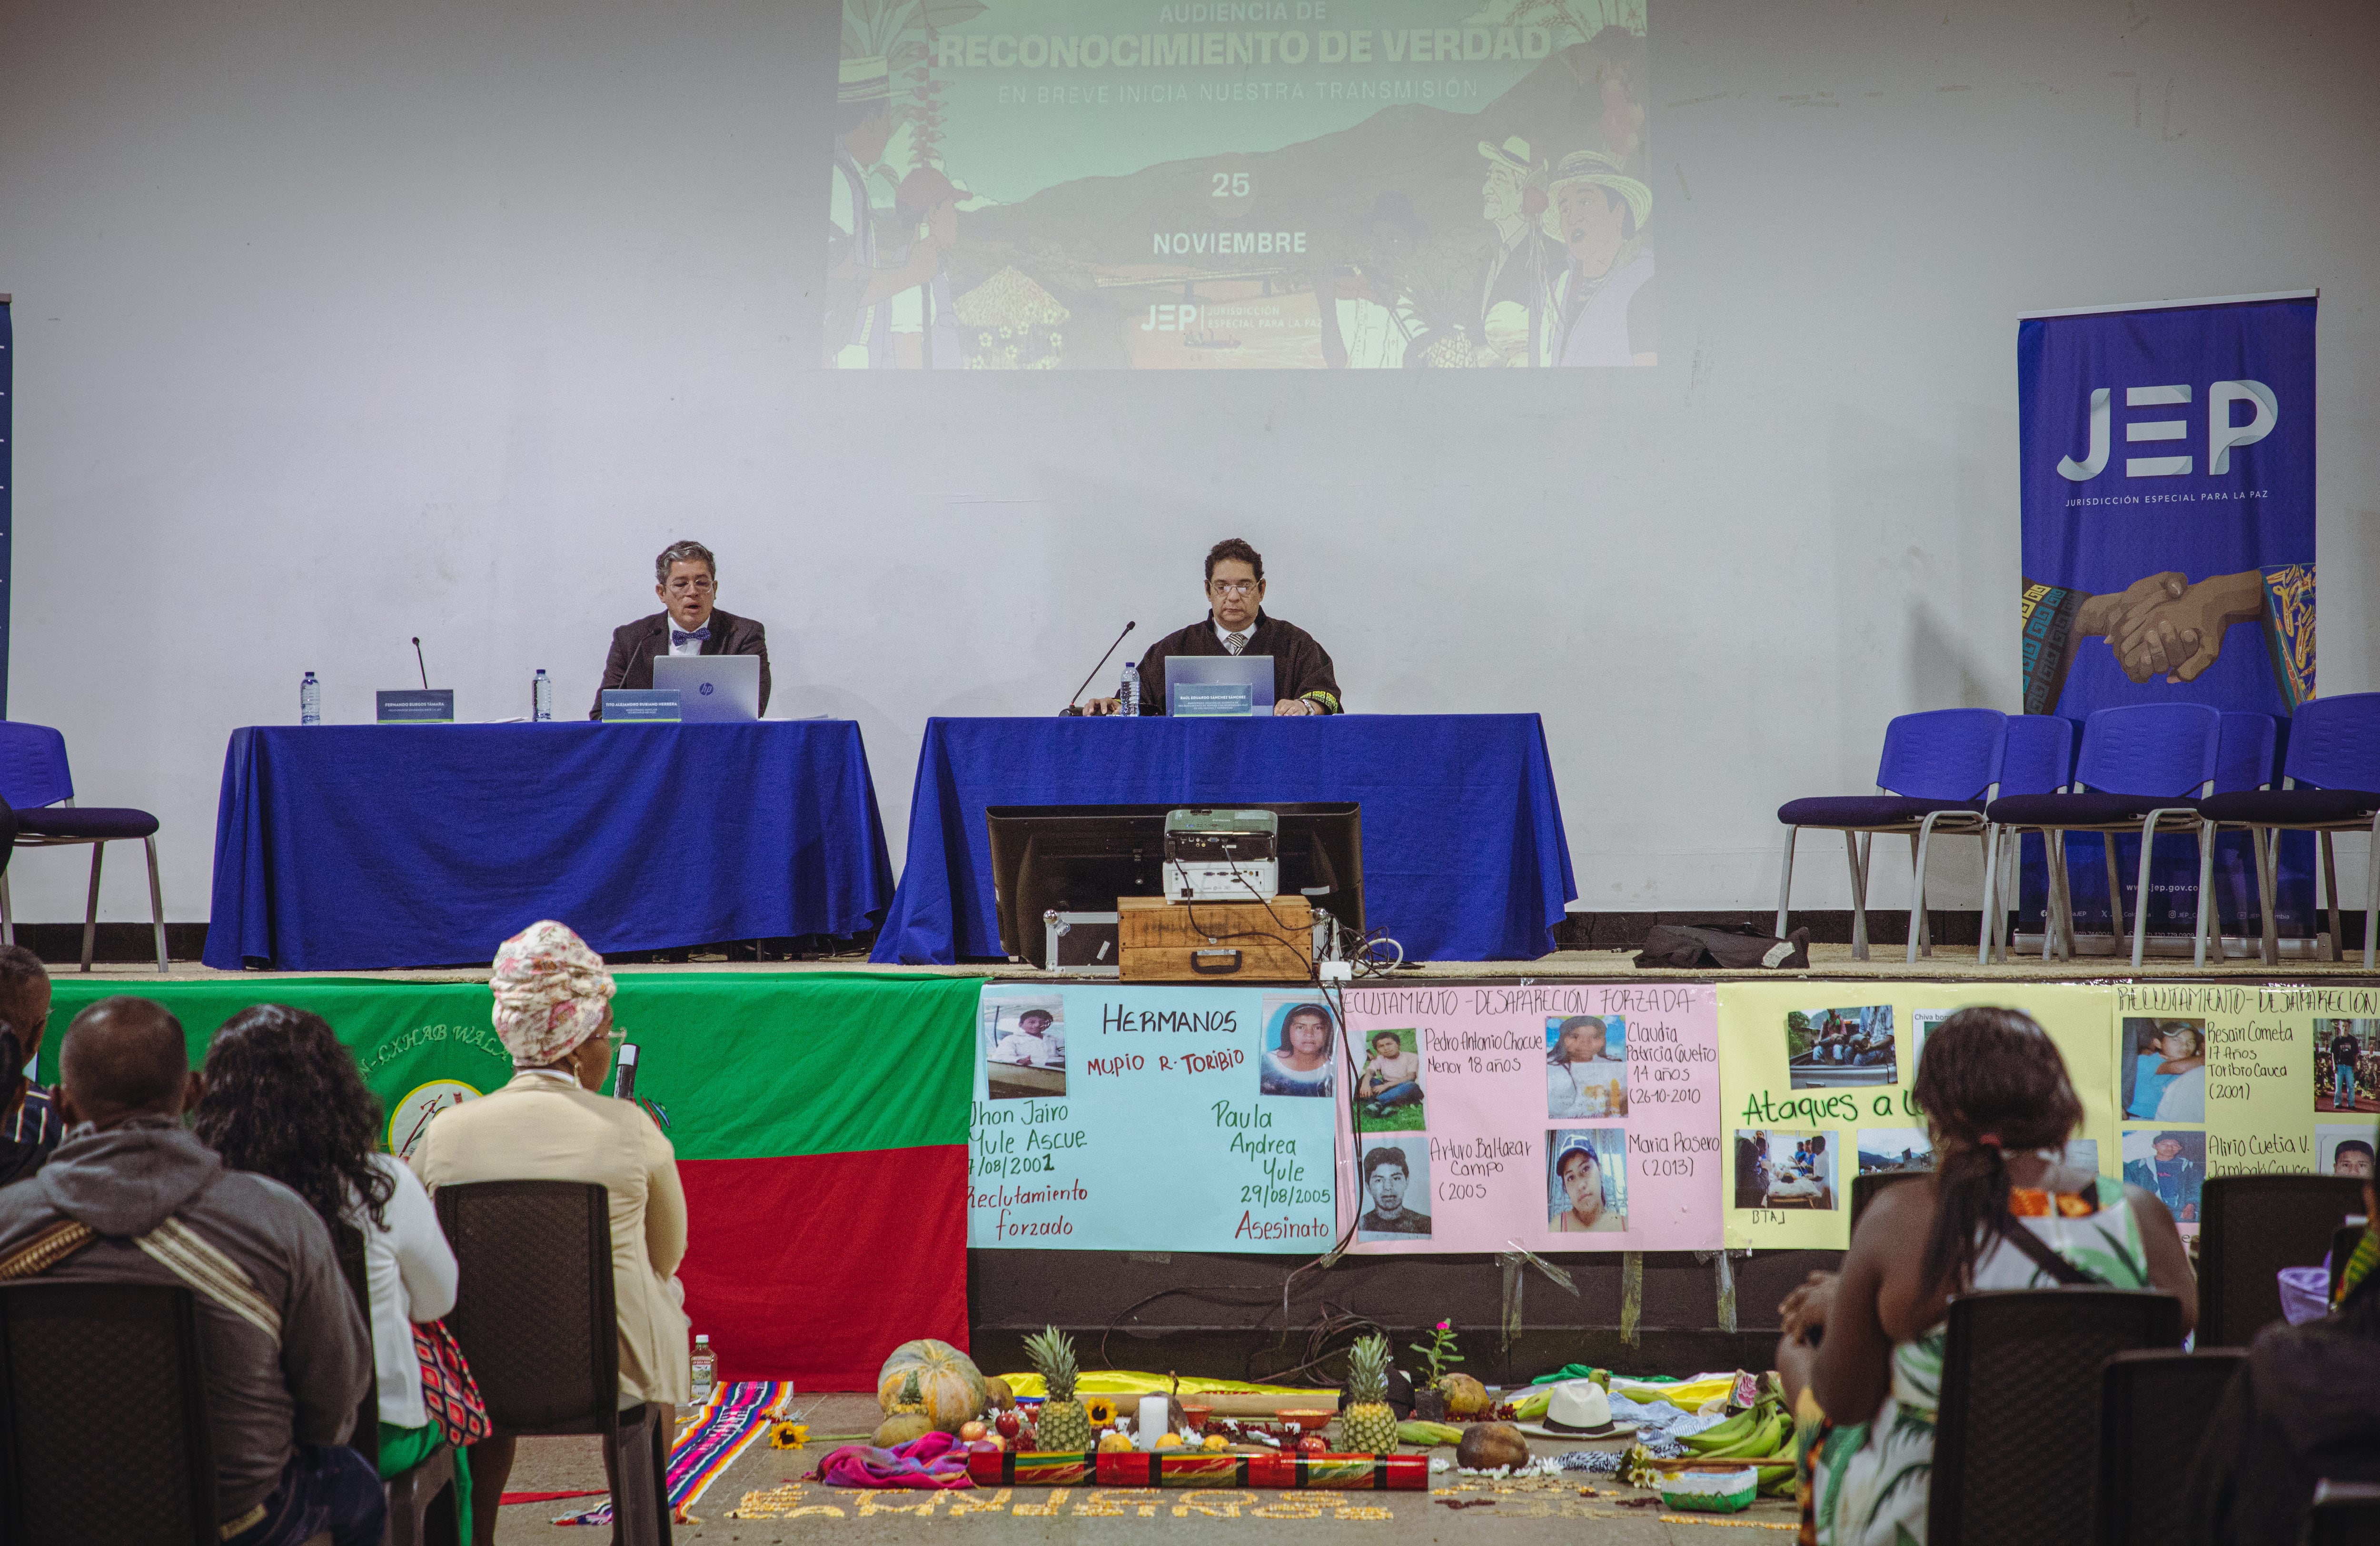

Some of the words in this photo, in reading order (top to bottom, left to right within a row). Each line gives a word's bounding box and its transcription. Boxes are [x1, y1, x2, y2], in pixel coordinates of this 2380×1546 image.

[1160, 2, 1288, 22] AUDIENCIA
[1297, 2, 1326, 20] DE
[937, 30, 1309, 68] RECONOCIMIENTO
[1319, 30, 1372, 62] DE
[1383, 27, 1551, 61] VERDAD
[1000, 86, 1026, 102] EN
[1038, 85, 1109, 103] BREVE
[1120, 84, 1189, 102] INICIA
[1200, 82, 1305, 101] NUESTRA
[1317, 77, 1476, 100] TRANSMISIÓN
[1212, 173, 1250, 197] 25
[1154, 232, 1306, 254] NOVIEMBRE
[1141, 304, 1197, 331] JEP
[1208, 319, 1254, 329] ESPECIAL
[1259, 319, 1284, 328] PARA
[1289, 319, 1302, 328] LA
[2056, 379, 2278, 481] JEP
[2065, 494, 2140, 507] JURISDICCIÓN
[2145, 493, 2195, 503] ESPECIAL
[2202, 492, 2228, 501] PARA
[2250, 490, 2268, 499] PAZ
[2126, 884, 2198, 892] ww.jep.gov.co
[1340, 989, 1458, 1015] ECLUTAMIENTO
[1600, 988, 1696, 1014] FORZADA
[2118, 986, 2245, 1014] RECLUTAMIENTO
[1102, 1003, 1238, 1035] HERMANOS
[2248, 1019, 2293, 1042] Cometa
[1425, 1028, 1458, 1052] Pedro
[1460, 1030, 1502, 1051] Antonio
[1627, 1021, 1678, 1043] Claudia
[1626, 1044, 1674, 1063] Patricia
[2209, 1046, 2219, 1060] 17
[2223, 1046, 2257, 1060] Años
[1428, 1056, 1461, 1074] Menor
[1468, 1056, 1482, 1073] 18
[1487, 1057, 1521, 1073] años
[1633, 1065, 1648, 1083] 14
[1654, 1067, 1690, 1081] años
[2207, 1062, 2252, 1077] Toribio
[2254, 1063, 2288, 1077] Cauca
[2209, 1082, 2250, 1100] (2001)
[970, 1101, 1014, 1127] Jhon
[1021, 1099, 1068, 1125] Jairo
[1211, 1100, 1272, 1129] Paula
[1742, 1089, 1859, 1127] Ataques
[1873, 1096, 1894, 1117] a
[969, 1129, 1014, 1157] Yule
[1230, 1132, 1296, 1164] Andrea
[1430, 1137, 1472, 1162] Arturo
[1475, 1137, 1532, 1159] Baltazar
[1629, 1134, 1669, 1154] Maria
[1674, 1131, 1720, 1153] Rosero
[2250, 1133, 2296, 1155] Cuetia
[1263, 1159, 1304, 1190] Yule
[1642, 1157, 1694, 1177] (2013)
[1240, 1185, 1331, 1208] 29/08/2005
[1234, 1210, 1329, 1240] Asesinato
